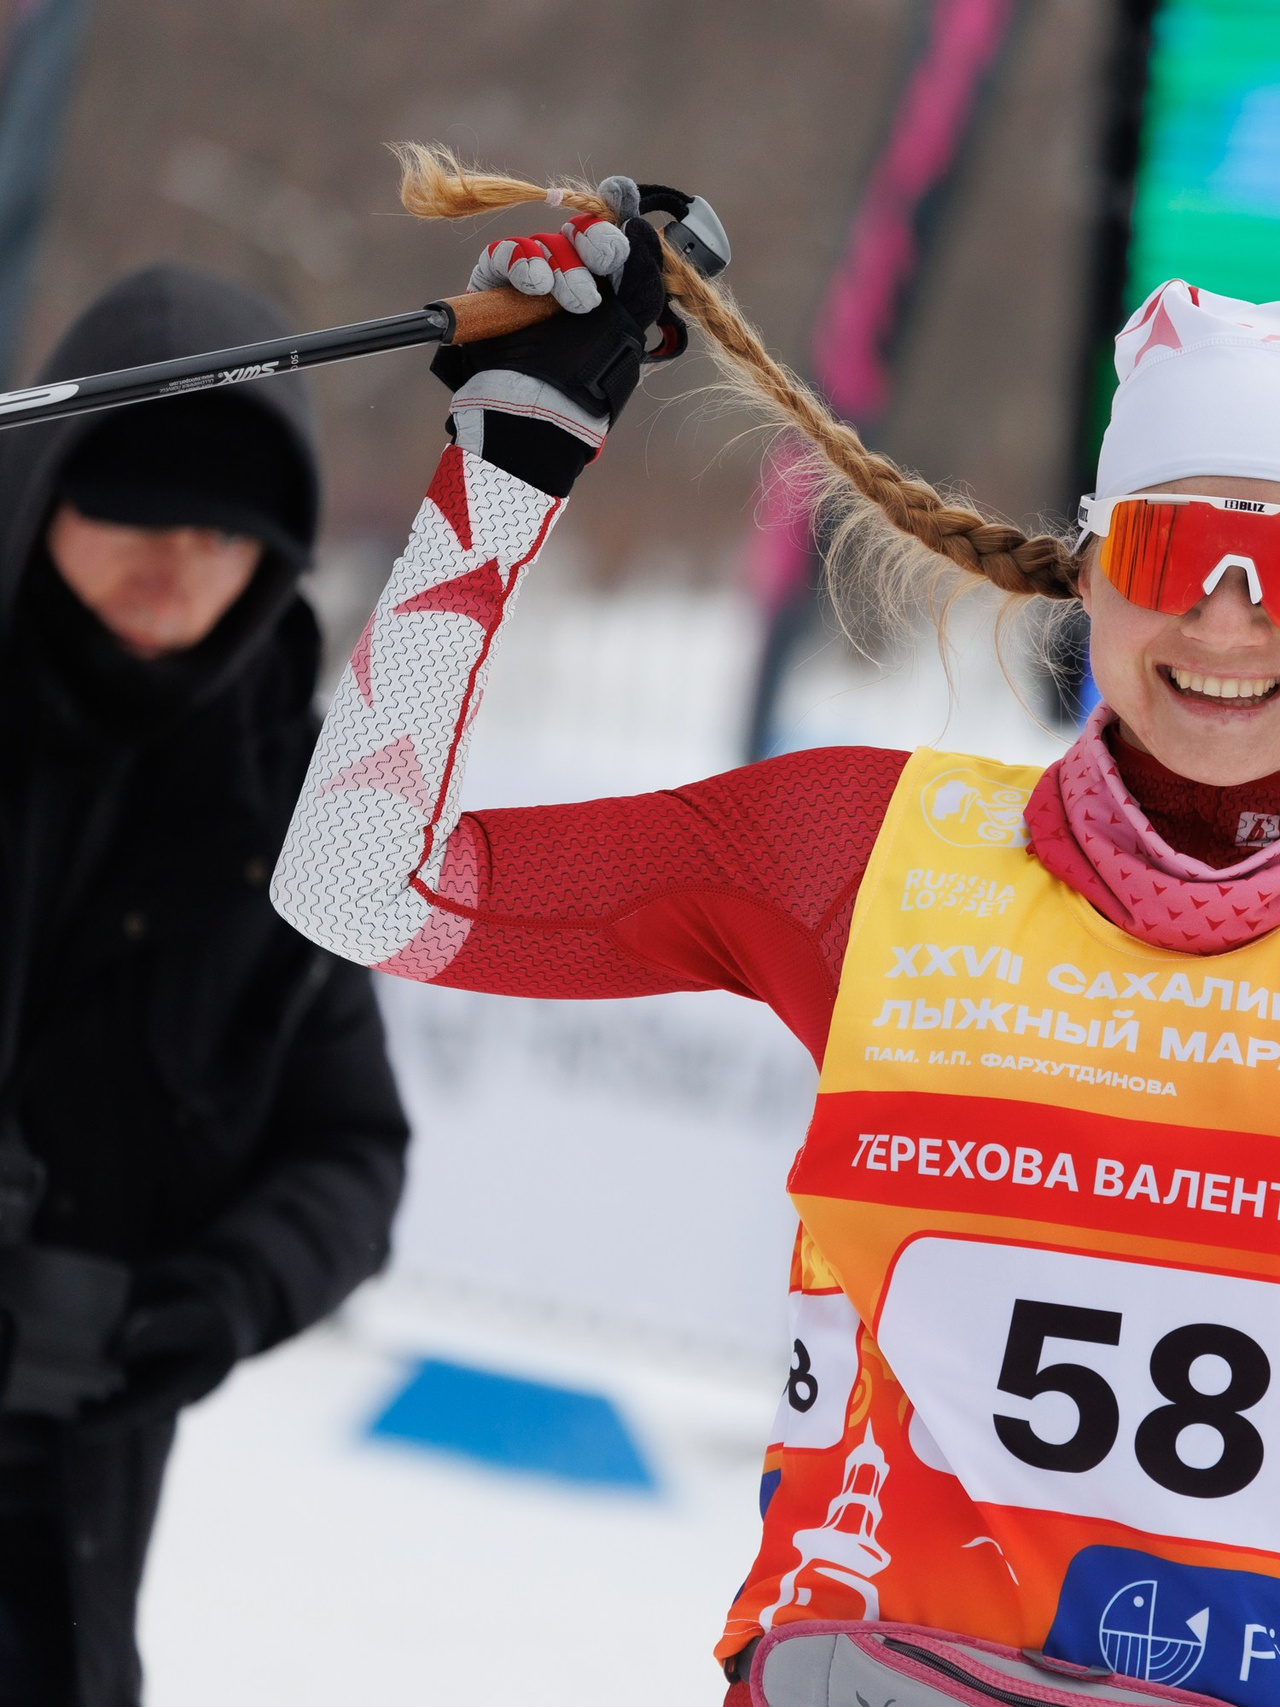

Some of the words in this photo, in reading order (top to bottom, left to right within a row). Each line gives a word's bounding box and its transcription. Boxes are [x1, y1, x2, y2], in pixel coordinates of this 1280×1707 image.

[1239, 502, 1266, 513] BLIZ
[905, 868, 1015, 901] RUSSIA
[884, 943, 1024, 985] XXVII
[872, 997, 1140, 1053] ЛЫЖНЫЙ
[864, 1046, 920, 1064] ПАМ.
[928, 1050, 972, 1066] И.П.
[980, 1052, 1177, 1096] ФАРХУТДИНОВА
[851, 1133, 1079, 1193] ТЕРЕХОВА
[782, 1338, 818, 1413] 8
[992, 1297, 1271, 1499] 58
